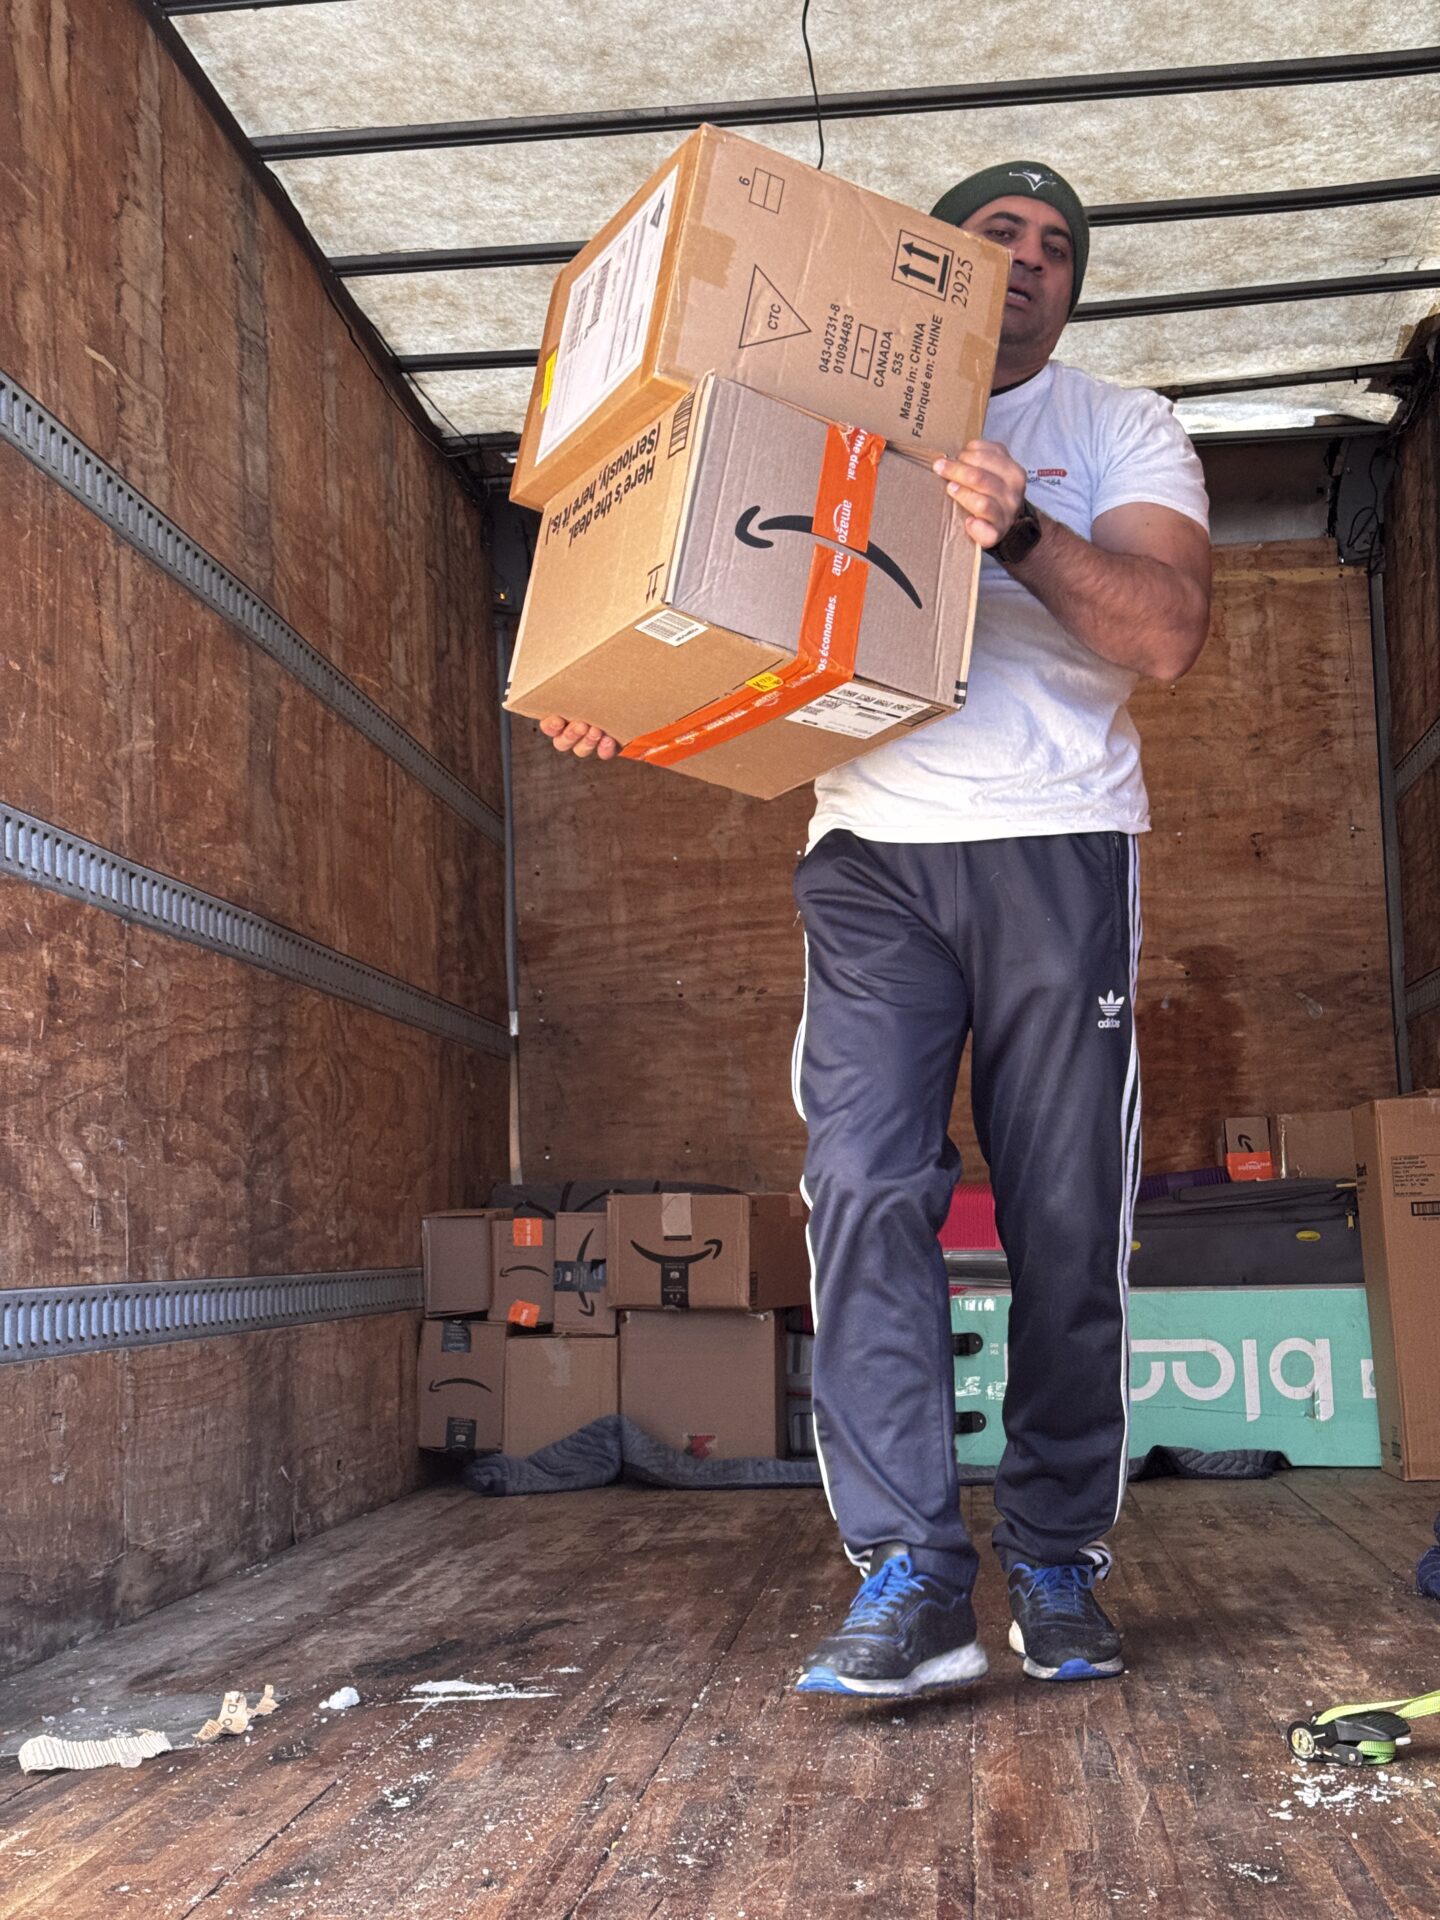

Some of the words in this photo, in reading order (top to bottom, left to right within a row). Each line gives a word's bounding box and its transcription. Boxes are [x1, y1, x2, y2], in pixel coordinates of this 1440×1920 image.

[951, 258, 973, 309] 2925
[767, 303, 782, 331] CTC
[819, 303, 841, 374] 043-0731-8
[833, 314, 854, 374] 01094483
[860, 346, 870, 355] 1
[909, 322, 927, 364] CHINA
[927, 315, 944, 357] CHINE
[873, 331, 894, 388] CANADA
[891, 352, 905, 375] 535
[905, 366, 919, 384] in:
[924, 358, 936, 380] en:
[899, 385, 915, 420] Made
[912, 381, 932, 438] Fabriqué
[852, 434, 866, 454] the
[615, 455, 657, 504] Here's
[846, 454, 860, 481] deal.
[562, 502, 572, 528] it
[572, 480, 597, 516] here
[593, 491, 613, 519] the
[568, 511, 593, 548] deal.
[818, 594, 838, 658] économies.
